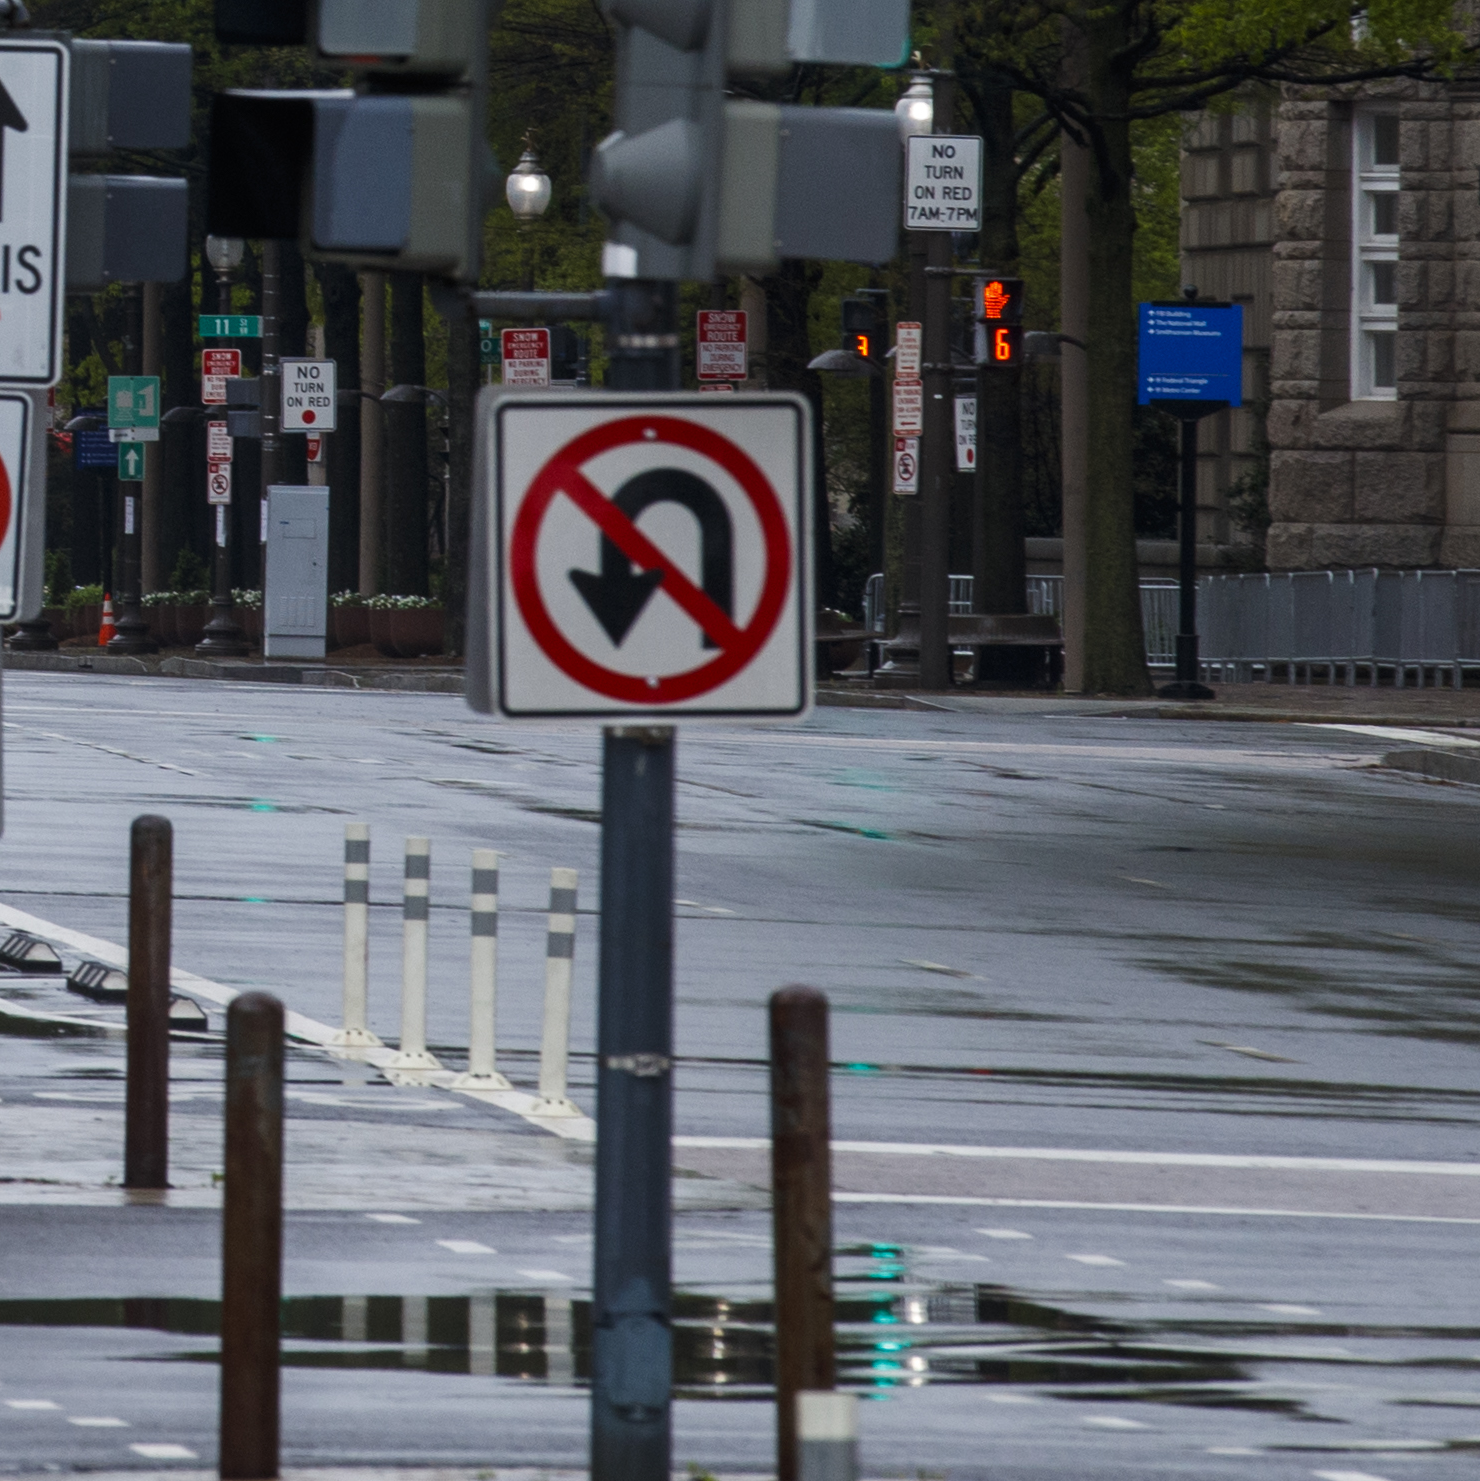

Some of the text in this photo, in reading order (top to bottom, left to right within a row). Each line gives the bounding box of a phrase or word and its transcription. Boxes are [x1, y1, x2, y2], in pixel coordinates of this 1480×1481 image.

[931, 144, 956, 159] NO
[924, 165, 964, 179] TURN
[914, 185, 973, 201] ON RED
[908, 205, 978, 221] 7AM-7PM
[708, 313, 737, 323] SNOW
[215, 318, 230, 335] 11
[513, 332, 538, 342] SNOW
[707, 331, 739, 341] ROUTE
[995, 328, 1010, 360] 6
[211, 352, 232, 361] SNOW
[513, 349, 538, 358] ROUTE
[297, 366, 320, 379] NO
[294, 382, 324, 393] TURN
[287, 396, 330, 408] ON RED
[962, 402, 975, 416] NO
